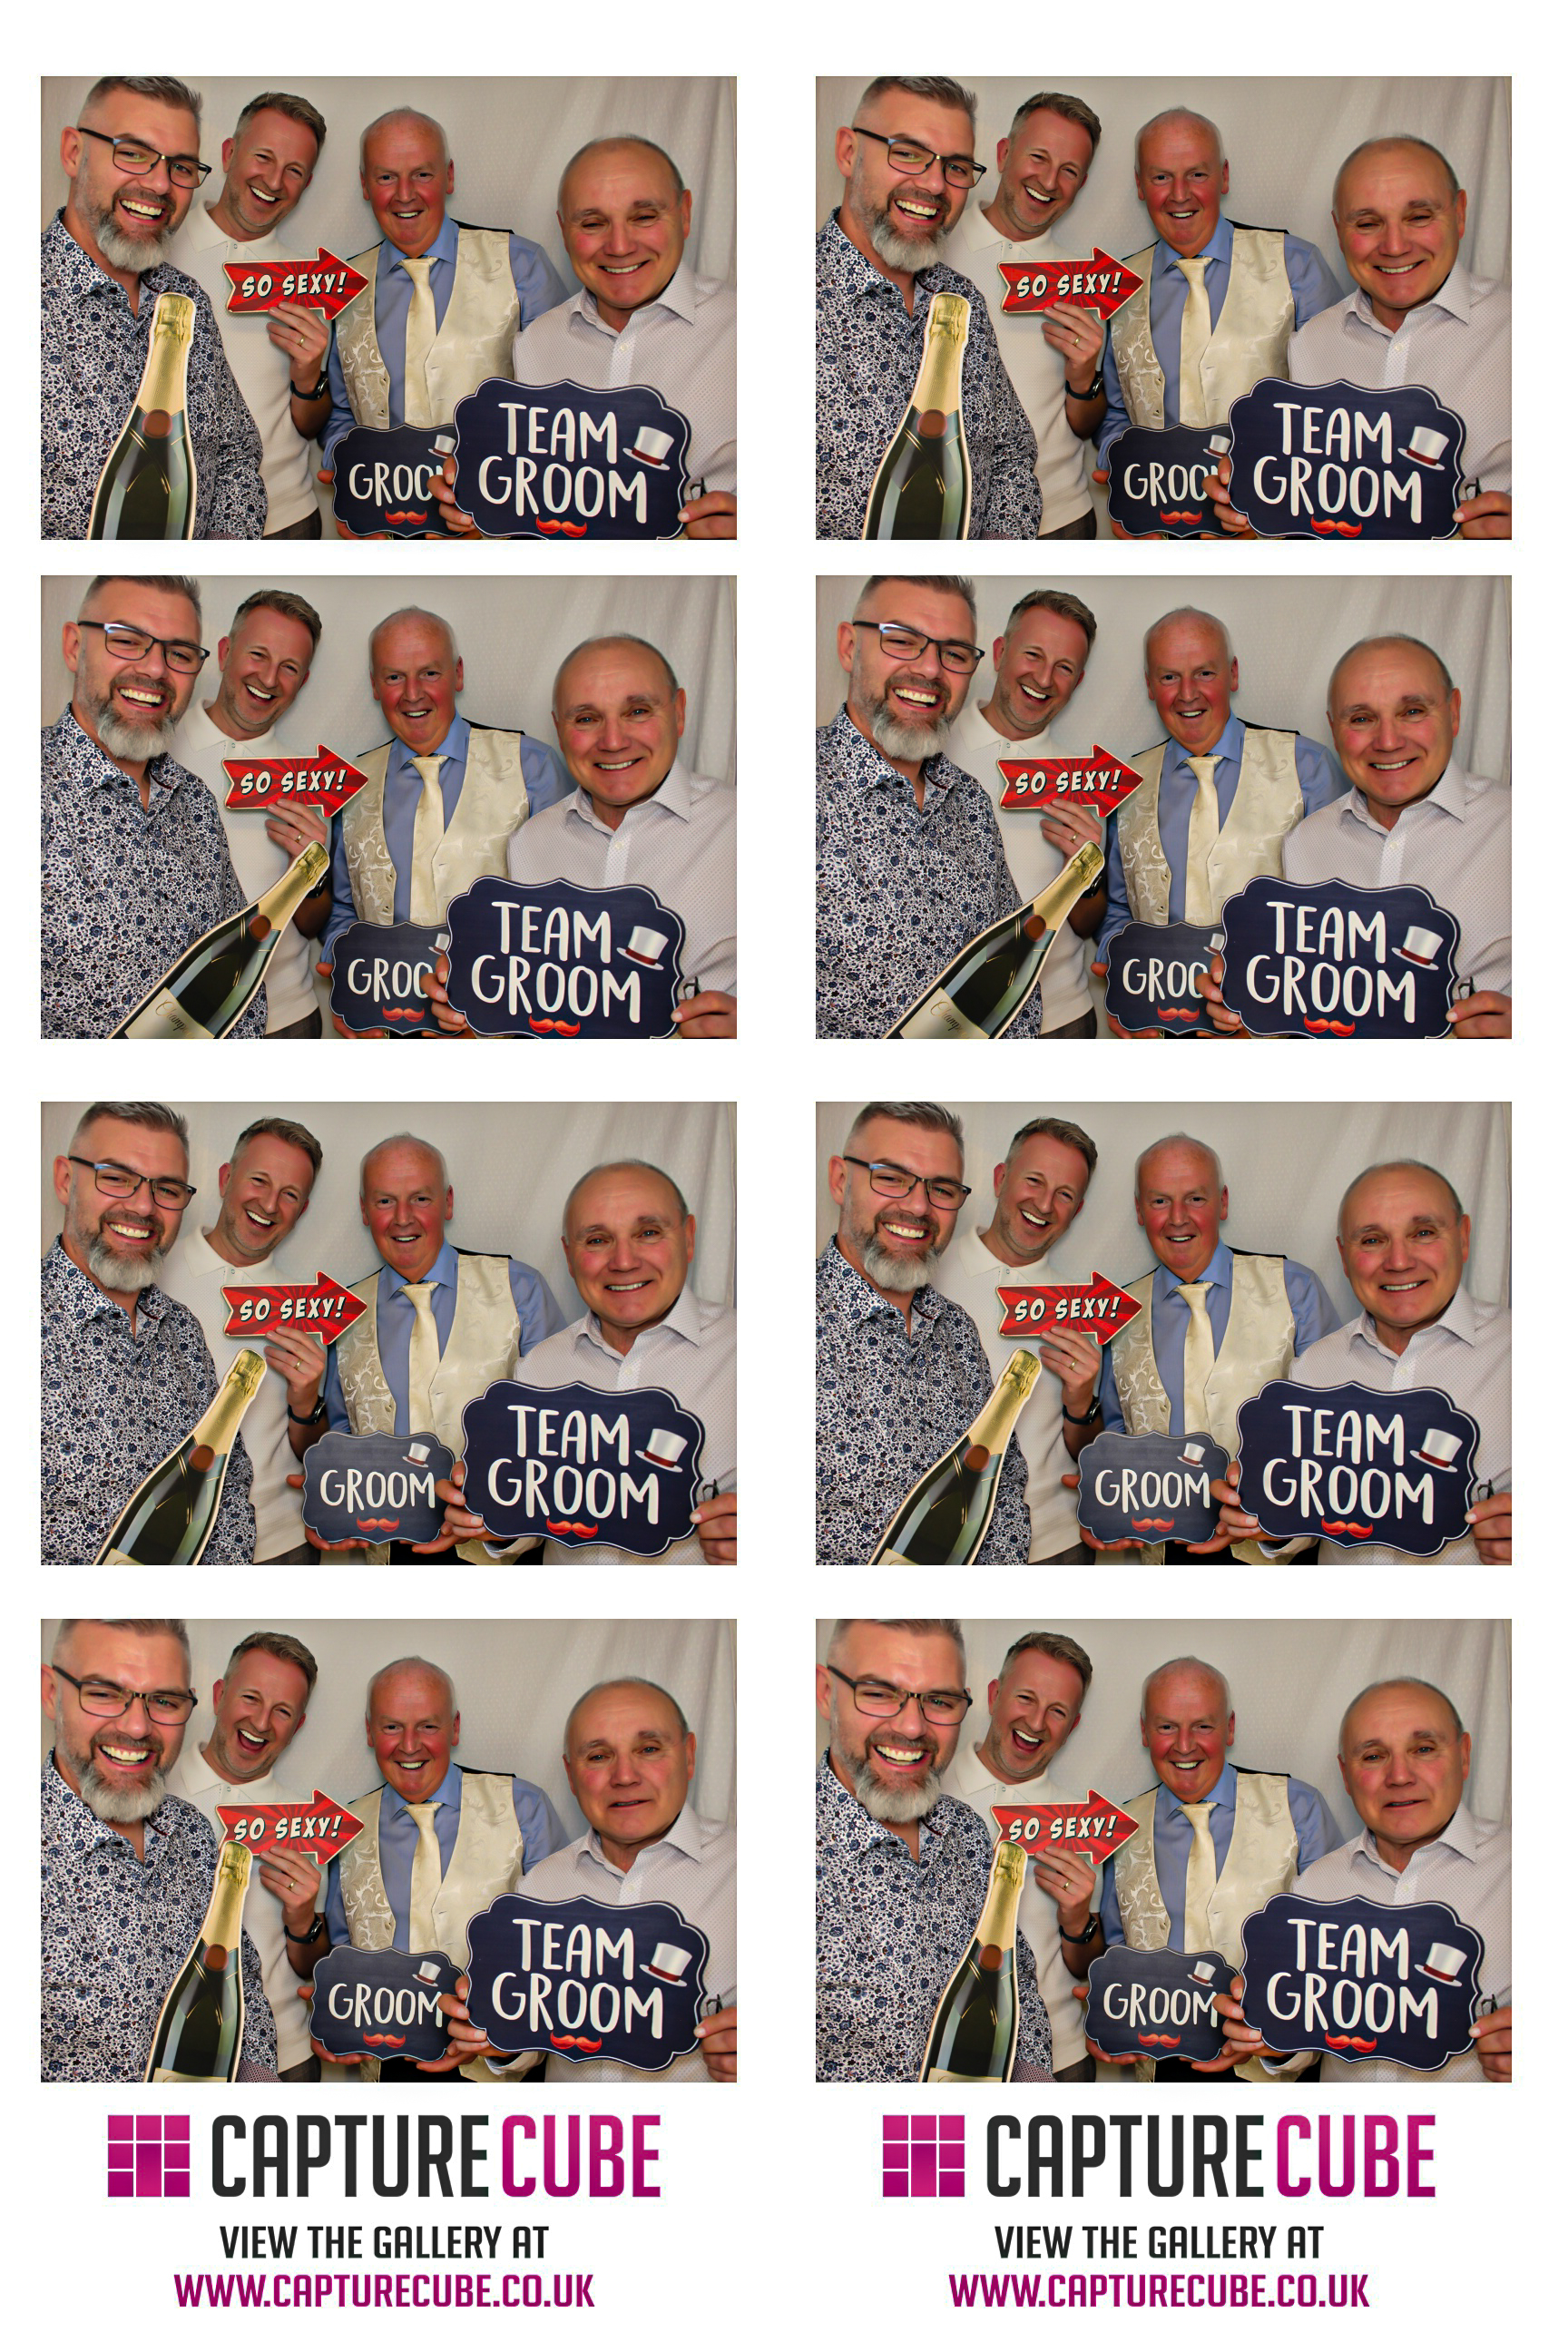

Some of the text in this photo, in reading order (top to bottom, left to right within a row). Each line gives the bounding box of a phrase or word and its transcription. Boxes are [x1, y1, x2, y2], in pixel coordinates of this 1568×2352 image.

[241, 271, 348, 299] SO SEXY!
[1016, 271, 1122, 299] SO SEXY!
[497, 402, 617, 465] TEAM
[1272, 402, 1392, 465] TEAM
[348, 462, 444, 507] GROO
[478, 456, 647, 524] GROOM
[1123, 462, 1219, 507] GROO
[1253, 456, 1422, 524] GROOM
[240, 769, 348, 795] SO SEXY!
[1015, 769, 1122, 795] SO SEXY!
[491, 901, 612, 964] TEAM
[1266, 901, 1387, 964] TEAM
[348, 957, 434, 1003] GROO
[471, 955, 641, 1024] GROOM
[1122, 957, 1209, 1003] GROO
[1246, 955, 1416, 1024] GROOM
[240, 1296, 347, 1322] SO SEXY!
[1014, 1296, 1122, 1322] SO SEXY!
[506, 1405, 630, 1466] TEAM
[1281, 1405, 1405, 1466] TEAM
[319, 1468, 436, 1514] GROOM
[487, 1457, 659, 1524] GROOM
[1094, 1468, 1210, 1514] GROOM
[1262, 1457, 1434, 1524] GROOM
[233, 1815, 343, 1842] SO SEXY!
[1008, 1815, 1118, 1842] SO SEXY!
[512, 1918, 634, 1981] TEAM
[1287, 1918, 1409, 1981] TEAM
[328, 1983, 444, 2028] GROOM
[492, 1972, 663, 2040] GROOM
[1103, 1983, 1219, 2028] GROOM
[1267, 1972, 1438, 2040] GROOM
